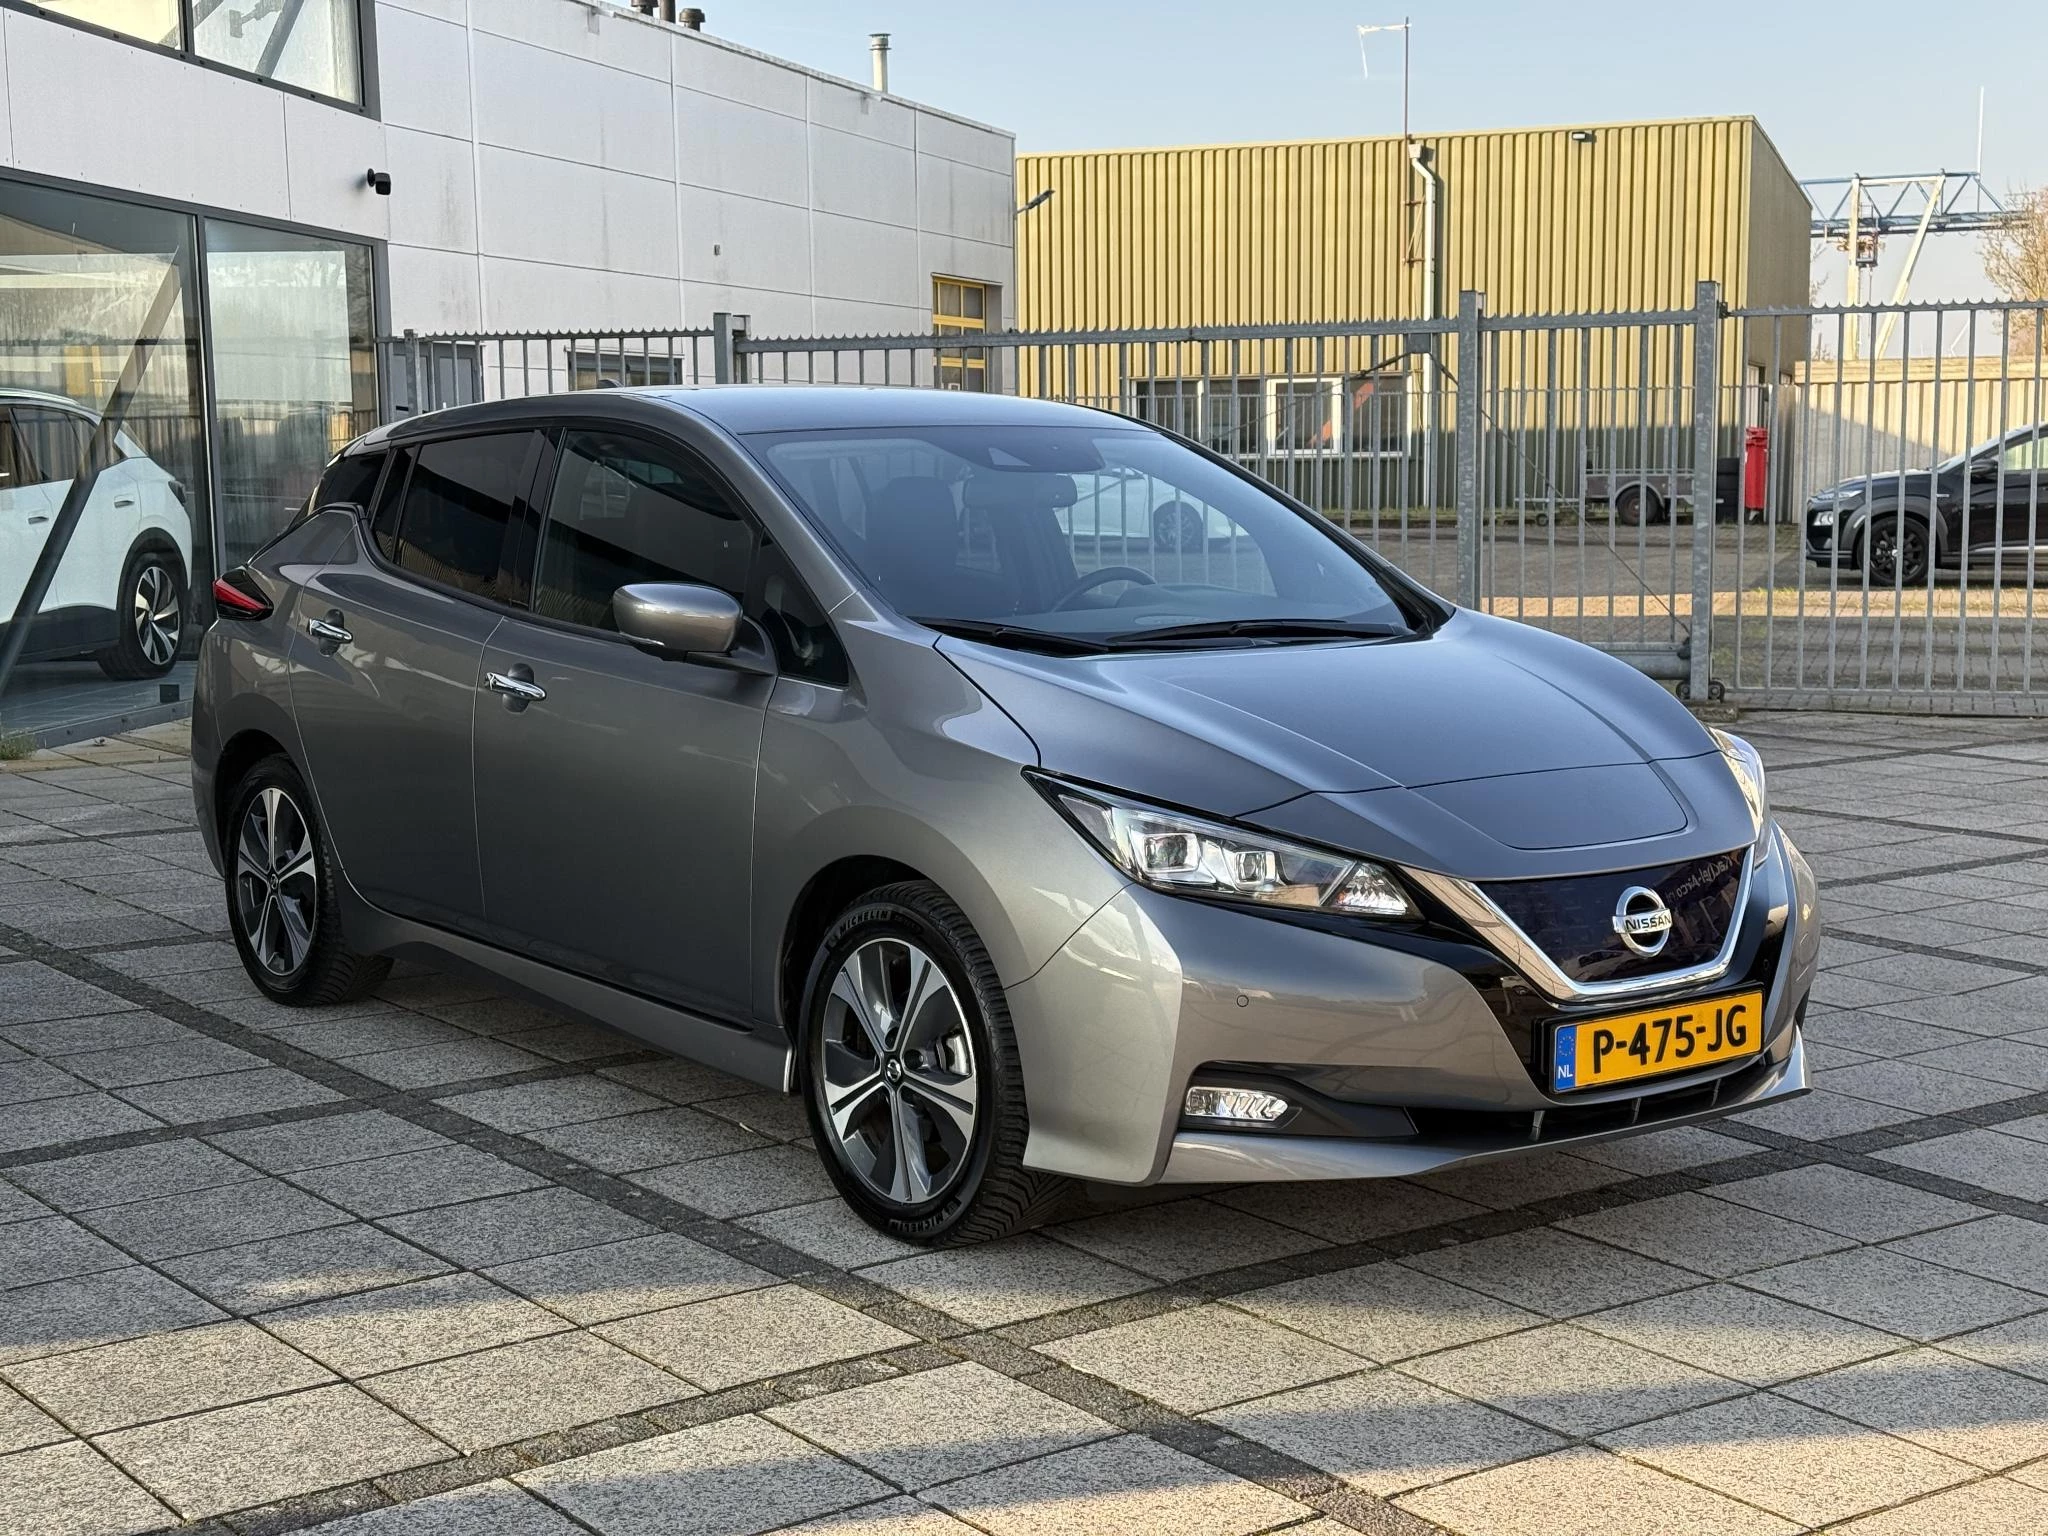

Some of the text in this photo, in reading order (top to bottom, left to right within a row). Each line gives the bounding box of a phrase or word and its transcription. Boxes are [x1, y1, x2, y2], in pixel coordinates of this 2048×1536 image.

[839, 910, 889, 933] MICHELIN
[1624, 914, 1672, 930] NISSAN
[1593, 1004, 1747, 1074] P-475-JG
[1557, 1064, 1574, 1080] NL
